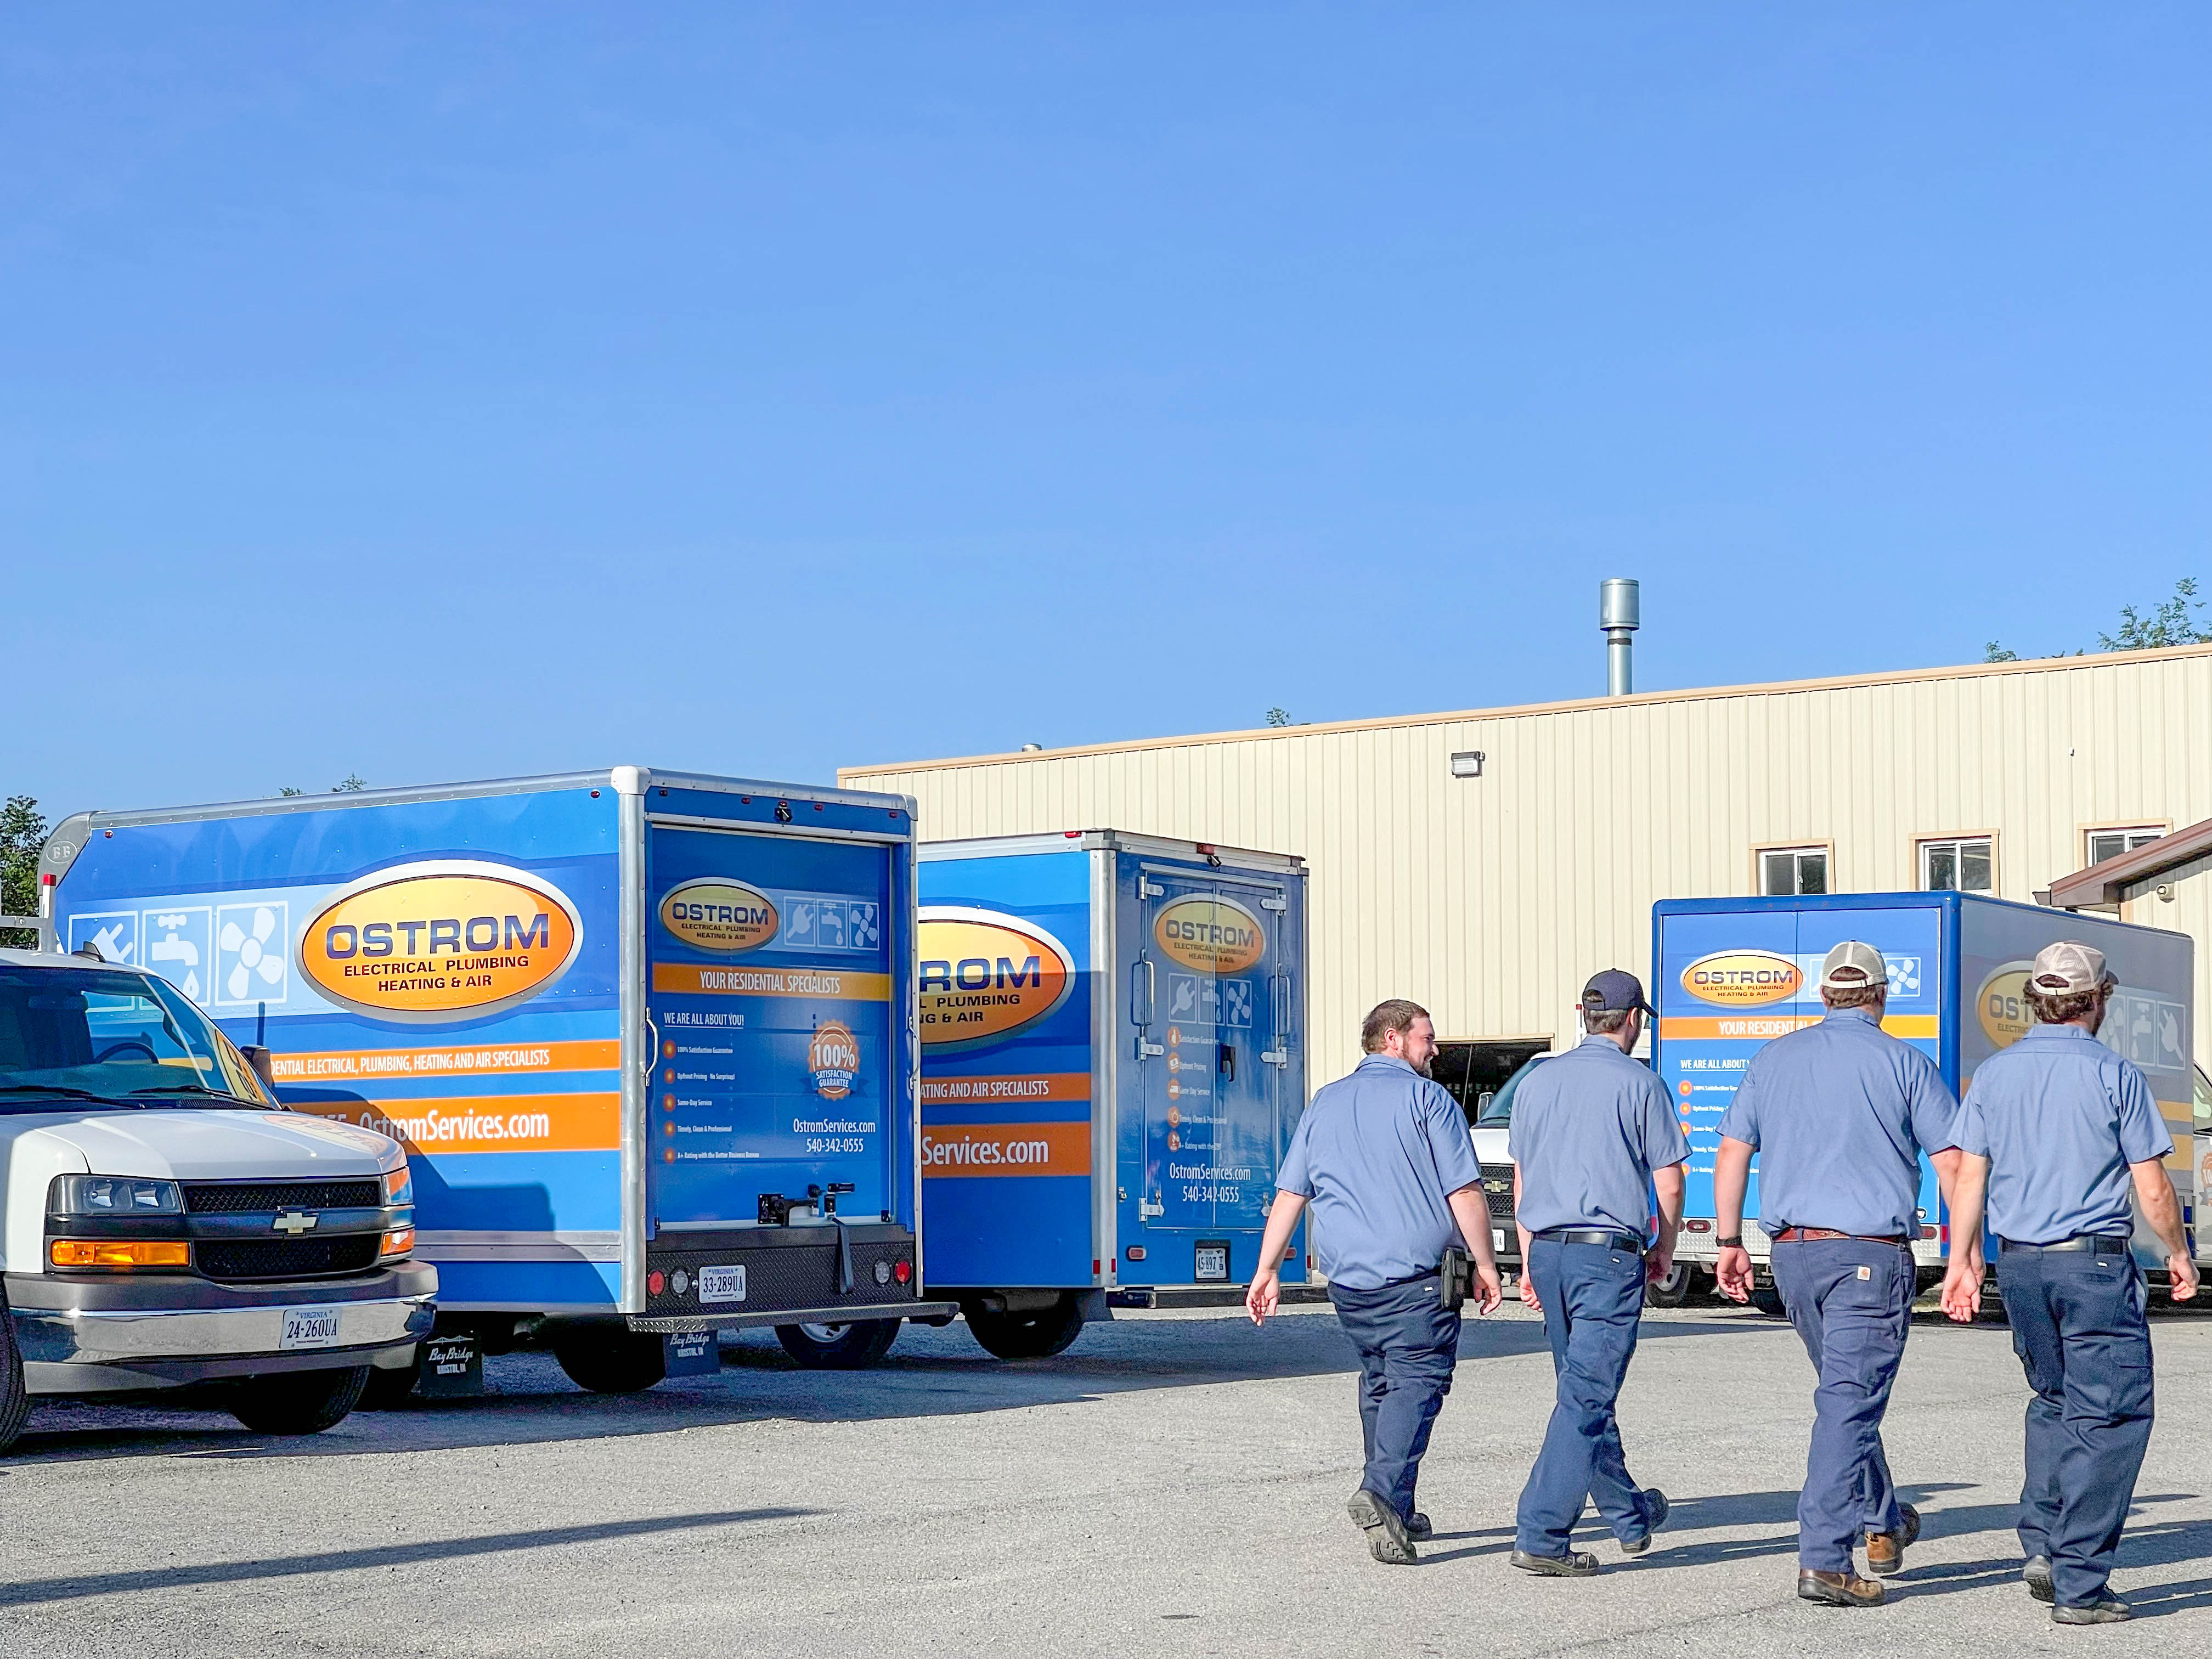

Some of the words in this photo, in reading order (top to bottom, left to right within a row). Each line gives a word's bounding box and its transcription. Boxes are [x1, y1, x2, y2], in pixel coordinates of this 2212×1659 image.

[672, 902, 768, 925] OSTROM
[326, 913, 549, 959] OSTROM
[1165, 919, 1254, 948] OSTROM
[1174, 942, 1213, 952] ELECTRICAL
[1217, 947, 1247, 956] PLUMBING
[1188, 953, 1217, 962] HEATING
[344, 962, 437, 977] ELECTRICAL
[445, 956, 529, 971] PLUMBING
[920, 956, 1040, 991] ROM
[378, 978, 445, 992] HEATING
[451, 977, 461, 988] &
[465, 974, 492, 987] AIR
[699, 971, 726, 989] YOUR
[728, 972, 783, 992] RESIDENTIAL
[787, 975, 840, 994] SPECIALISTS
[1694, 970, 1792, 984] OSTROM
[937, 994, 1020, 1008] PLUMBING
[1990, 994, 2037, 1023] OST
[664, 1012, 676, 1024] WE
[676, 1013, 690, 1024] ARE
[691, 1013, 703, 1025] ALL
[704, 1013, 727, 1025] ABOUT
[728, 1014, 744, 1026] YOU!
[942, 1013, 952, 1023] &
[957, 1011, 984, 1023] AIR
[1718, 1021, 1746, 1035] YOUR
[271, 1060, 306, 1076] DENTIAL
[308, 1058, 358, 1075] ELECTRICAL,
[360, 1055, 412, 1073] PLUMBING,
[414, 1053, 453, 1070] HEATING
[454, 1052, 474, 1069] AND
[475, 1051, 491, 1068] AIR
[493, 1049, 550, 1067] SPECIALISTS
[814, 1044, 855, 1067] 100%
[1680, 1059, 1692, 1069] WE
[1693, 1059, 1706, 1069] ARE
[1708, 1059, 1720, 1069] ALL
[1722, 1059, 1747, 1069] ABOUT
[816, 1070, 853, 1080] SATISFACTION
[819, 1079, 849, 1087] GUARANTEE
[921, 1084, 947, 1098] ATING
[949, 1083, 970, 1097] AND
[972, 1082, 989, 1097] AIR
[991, 1080, 1049, 1096] SPECIALISTS
[793, 1118, 876, 1133] OstromServices.com
[806, 1138, 864, 1152] 540-342-0555
[922, 1136, 1048, 1165] Services.com
[1170, 1162, 1251, 1180] OstromServices.com
[1183, 1186, 1239, 1203] 540-342-0555
[703, 1276, 743, 1293] 33-289UA
[286, 1318, 337, 1339] 24-260UA
[670, 1333, 685, 1347] Bay
[685, 1333, 709, 1346] Bridge
[428, 1347, 446, 1364] Bay
[446, 1346, 473, 1362] Bridge
